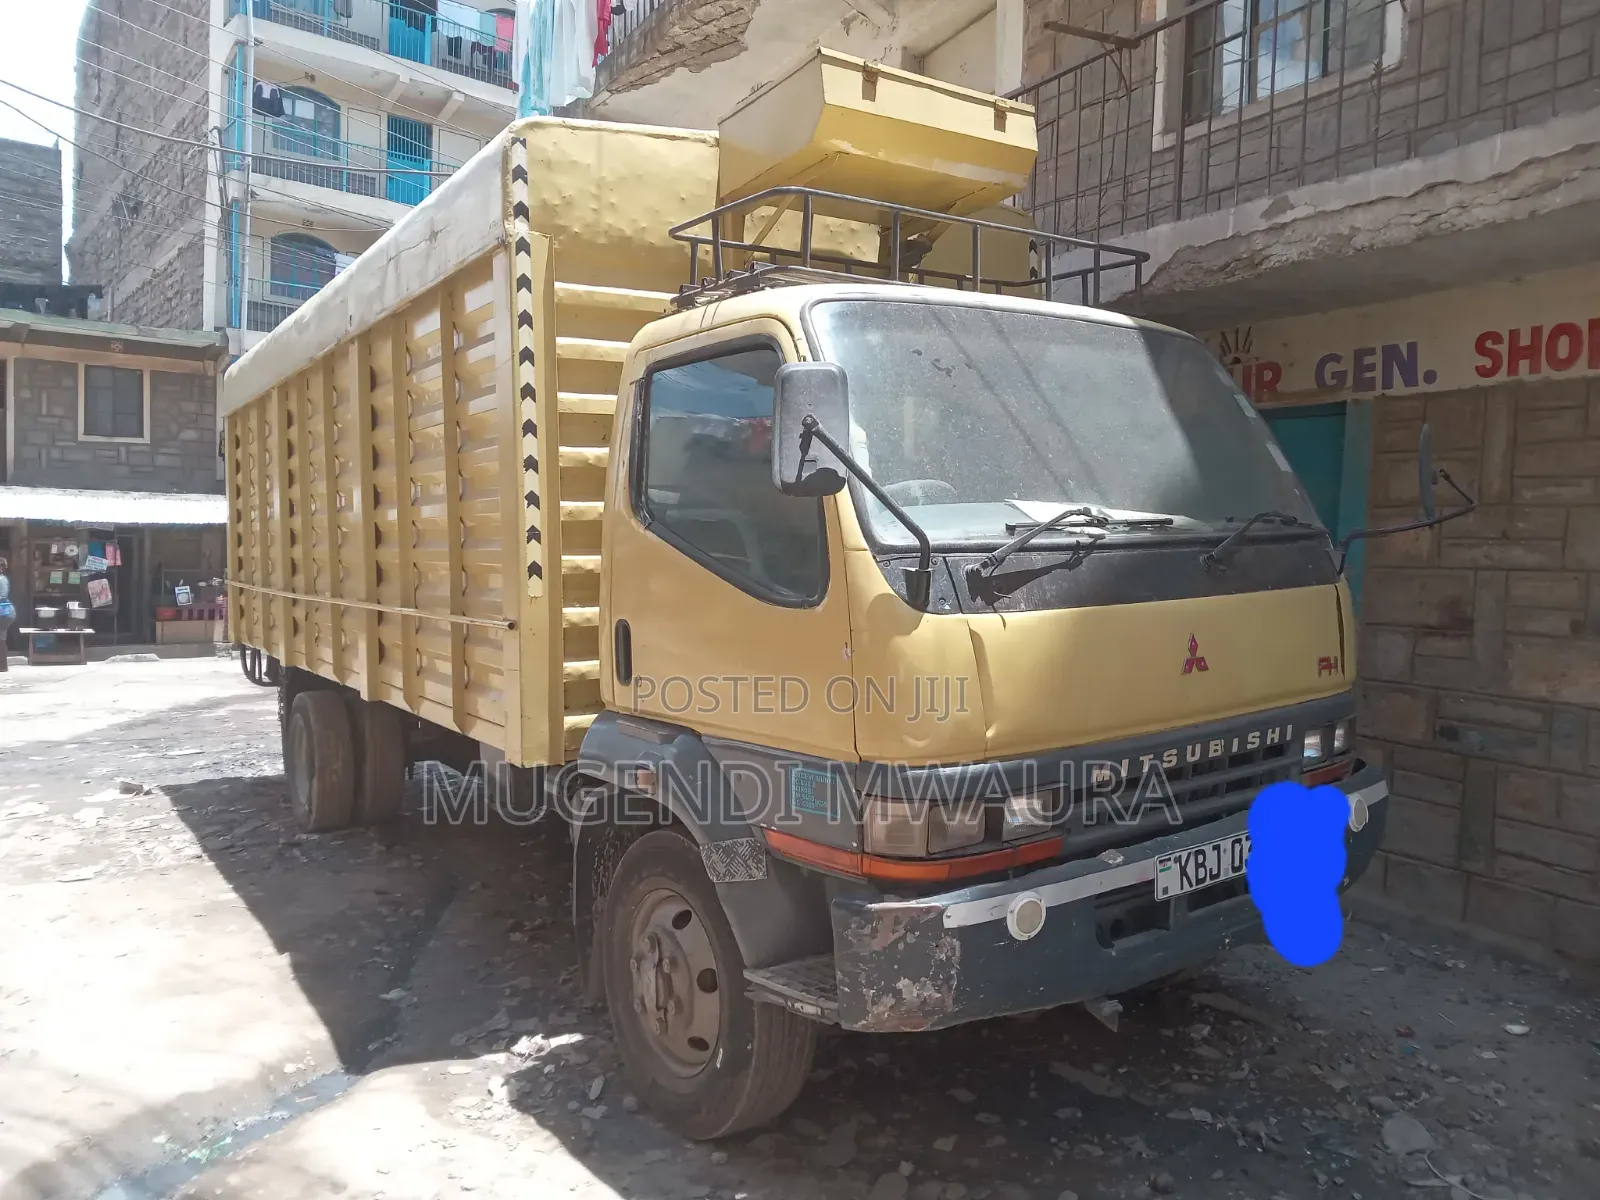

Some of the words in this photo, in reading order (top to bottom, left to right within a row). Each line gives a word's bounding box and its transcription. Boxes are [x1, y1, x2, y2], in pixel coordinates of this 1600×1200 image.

[1314, 341, 1438, 393] GEN.
[1090, 723, 1294, 784] MITSUBISHI
[1178, 844, 1221, 891] KBJ
